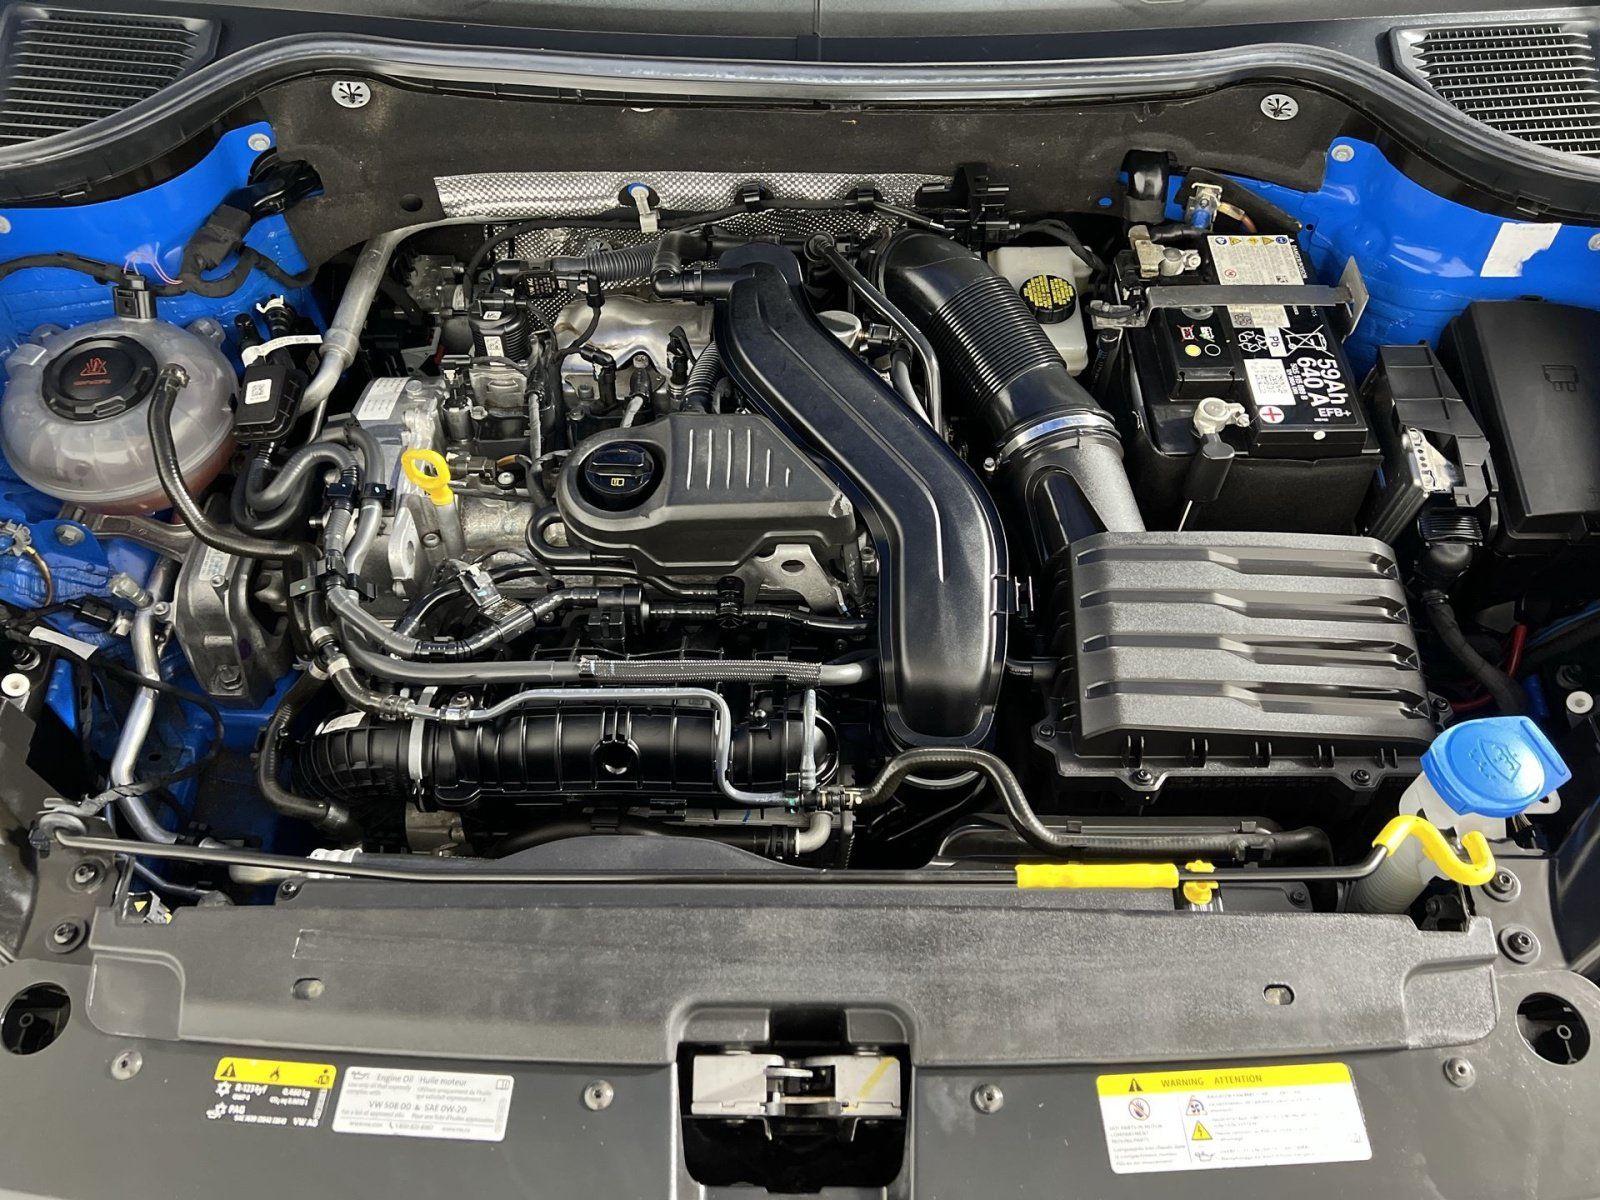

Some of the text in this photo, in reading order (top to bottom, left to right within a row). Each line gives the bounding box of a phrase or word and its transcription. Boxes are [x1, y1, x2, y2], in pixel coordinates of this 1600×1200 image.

[1269, 335, 1280, 347] Pb
[1297, 357, 1324, 389] 640
[1317, 358, 1349, 405] 59Ah
[1307, 392, 1330, 407] A
[1317, 407, 1351, 417] EFB+
[377, 1073, 467, 1087] Engine Oil Huile moteur
[1161, 1074, 1263, 1088] WARNING ATTENTION
[369, 1101, 383, 1109] VW
[400, 1102, 412, 1110] 00
[424, 1103, 439, 1111] SAE
